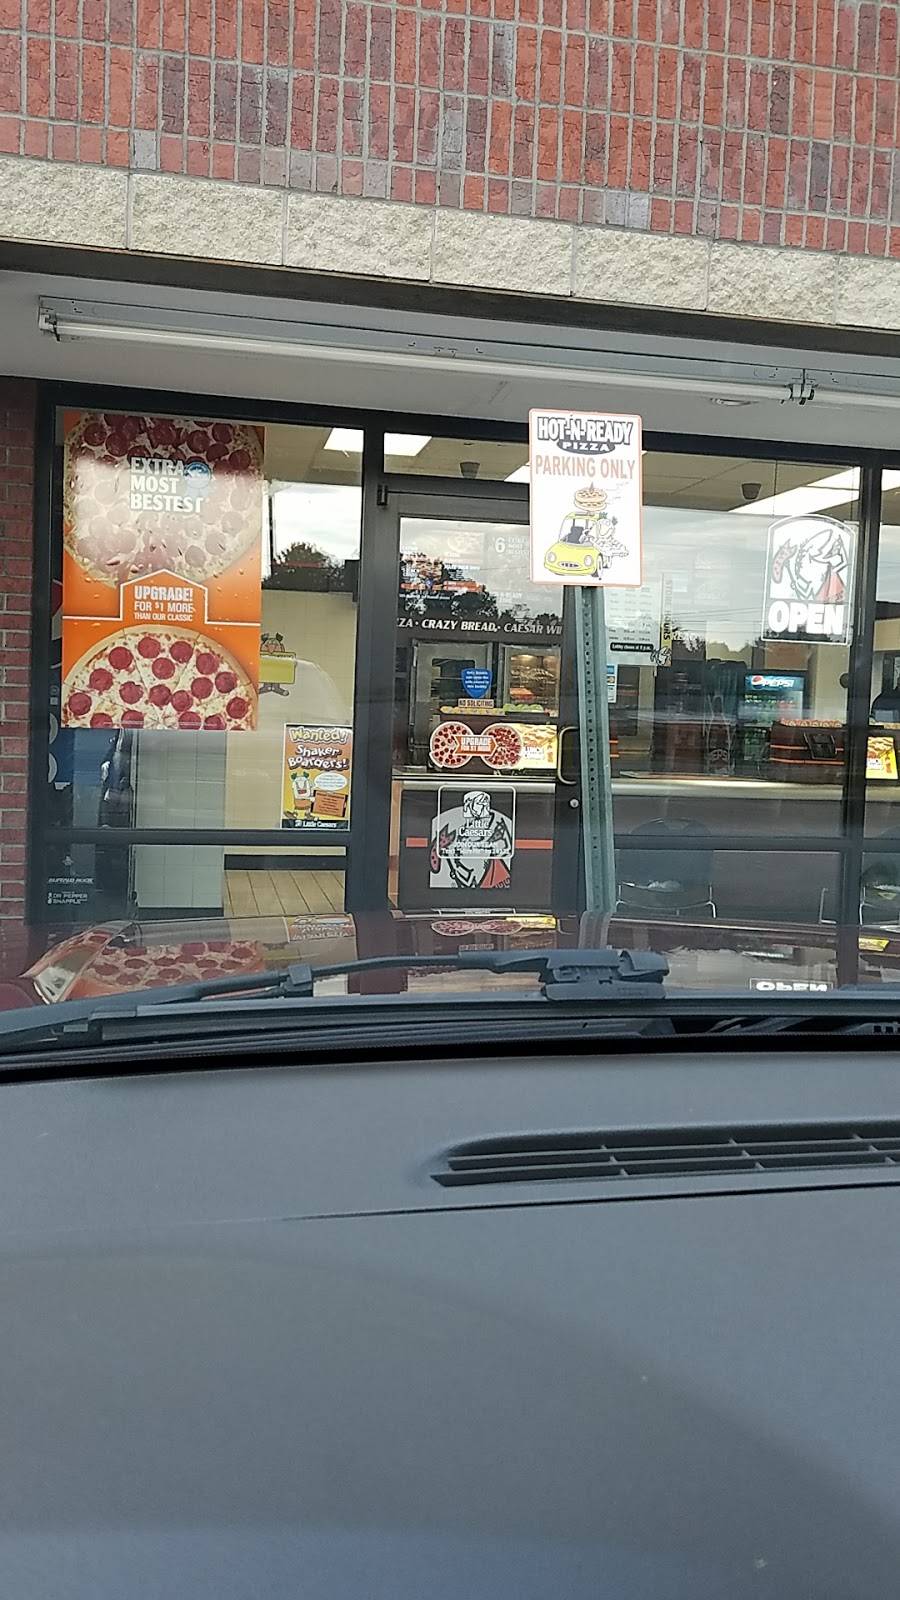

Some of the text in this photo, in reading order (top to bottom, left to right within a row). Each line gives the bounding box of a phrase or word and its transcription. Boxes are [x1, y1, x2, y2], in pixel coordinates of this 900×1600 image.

[537, 416, 634, 446] HOT-N-READY
[562, 441, 611, 452] PIZZA
[130, 457, 184, 477] EXTRA
[535, 455, 635, 479] PARKING ONLY
[130, 475, 179, 494] MOST
[130, 493, 205, 513] BESTEST
[134, 585, 193, 602] UPGRADE!
[134, 601, 193, 613] FOR $1 MORE
[134, 612, 193, 622] THAN OUR CLASSIC
[767, 601, 845, 635] OPEN
[421, 618, 458, 630] CRAZY
[503, 622, 544, 634] CAESAR
[289, 726, 347, 743] Wanted!
[297, 744, 341, 757] Shaker
[288, 756, 349, 770] Boarders!
[303, 820, 316, 829] Little
[460, 826, 492, 837] Caesars
[466, 819, 489, 829] Little
